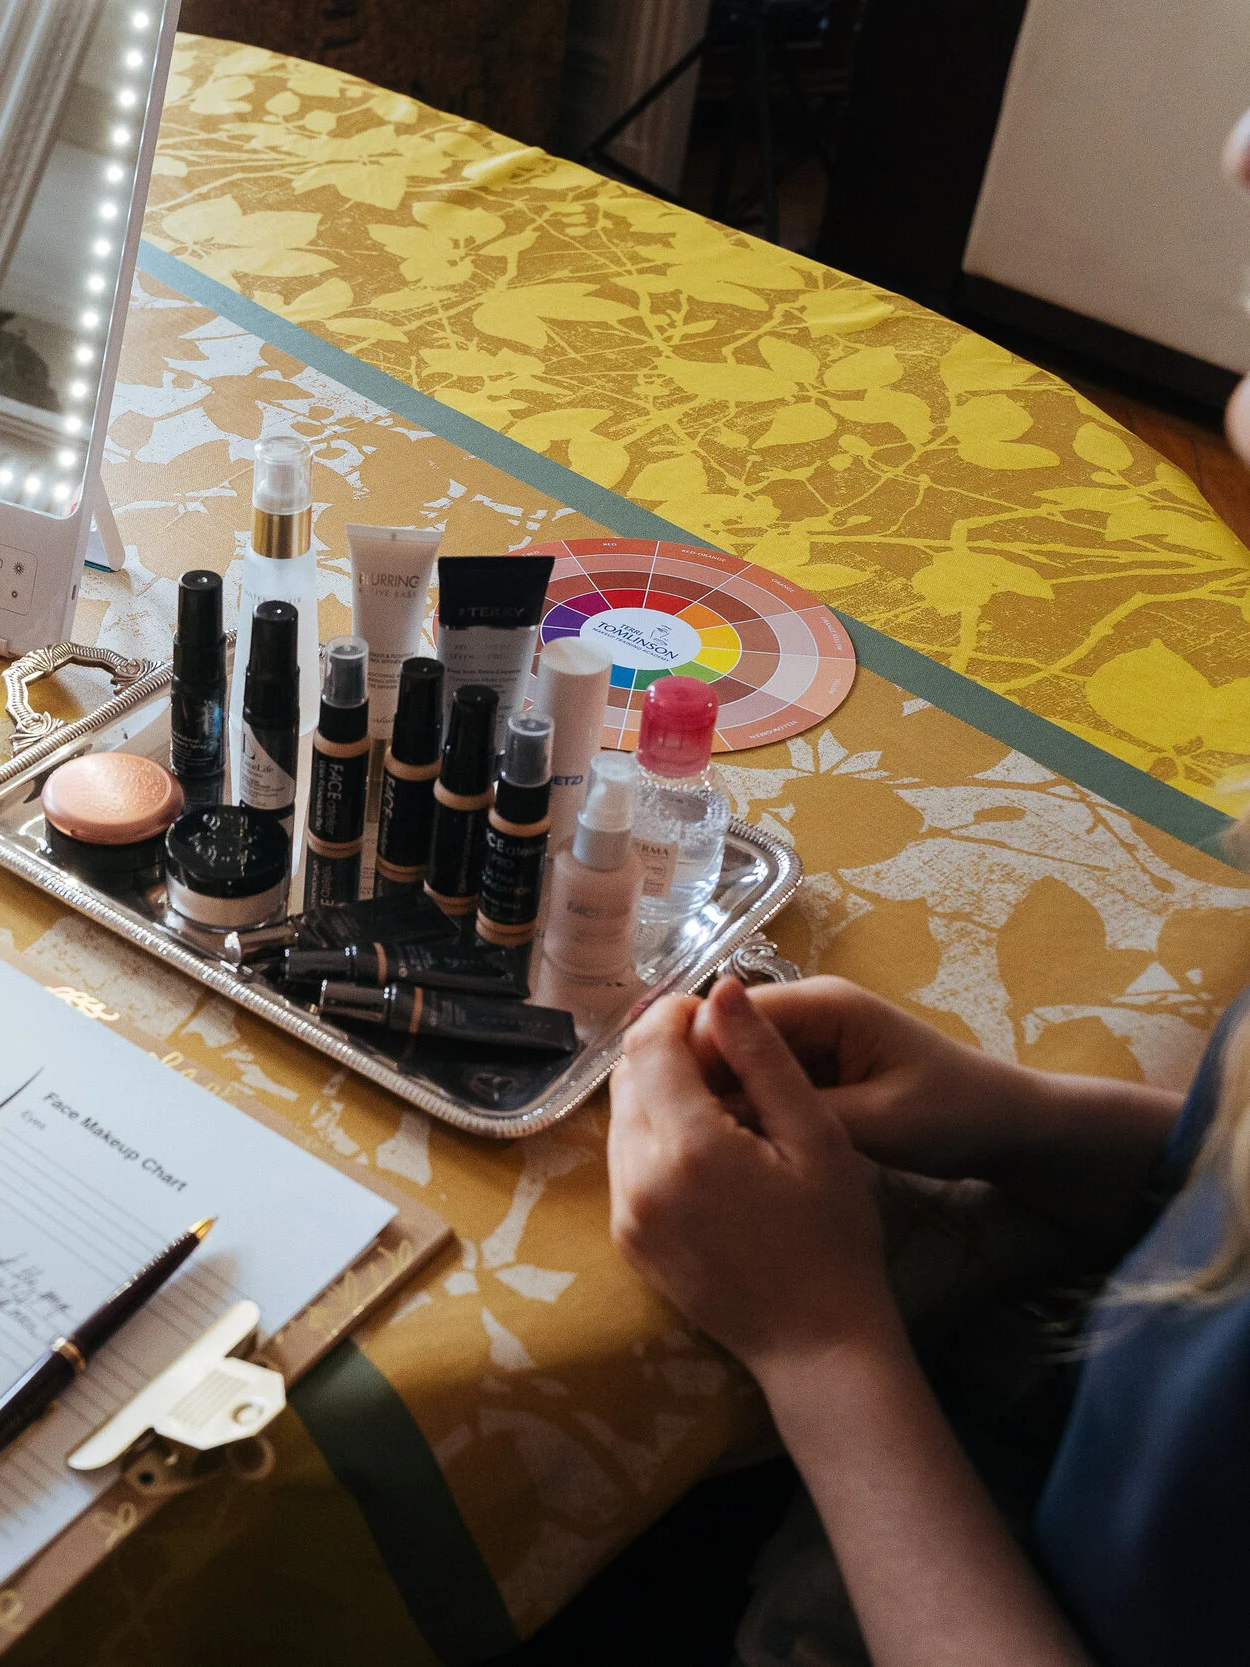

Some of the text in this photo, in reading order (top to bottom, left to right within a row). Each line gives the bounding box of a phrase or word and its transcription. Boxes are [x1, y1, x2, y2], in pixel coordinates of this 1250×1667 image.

[681, 548, 727, 563] RED-ORANGE
[771, 577, 796, 594] ORANGE
[592, 627, 670, 662] MAKEUP TRAINING ACADEMY
[597, 620, 679, 660] TOMLINSON
[620, 623, 643, 636] TERRI
[327, 763, 344, 800] FACE
[382, 775, 396, 819] FACE
[43, 1091, 188, 1193] Face Makeup Chart
